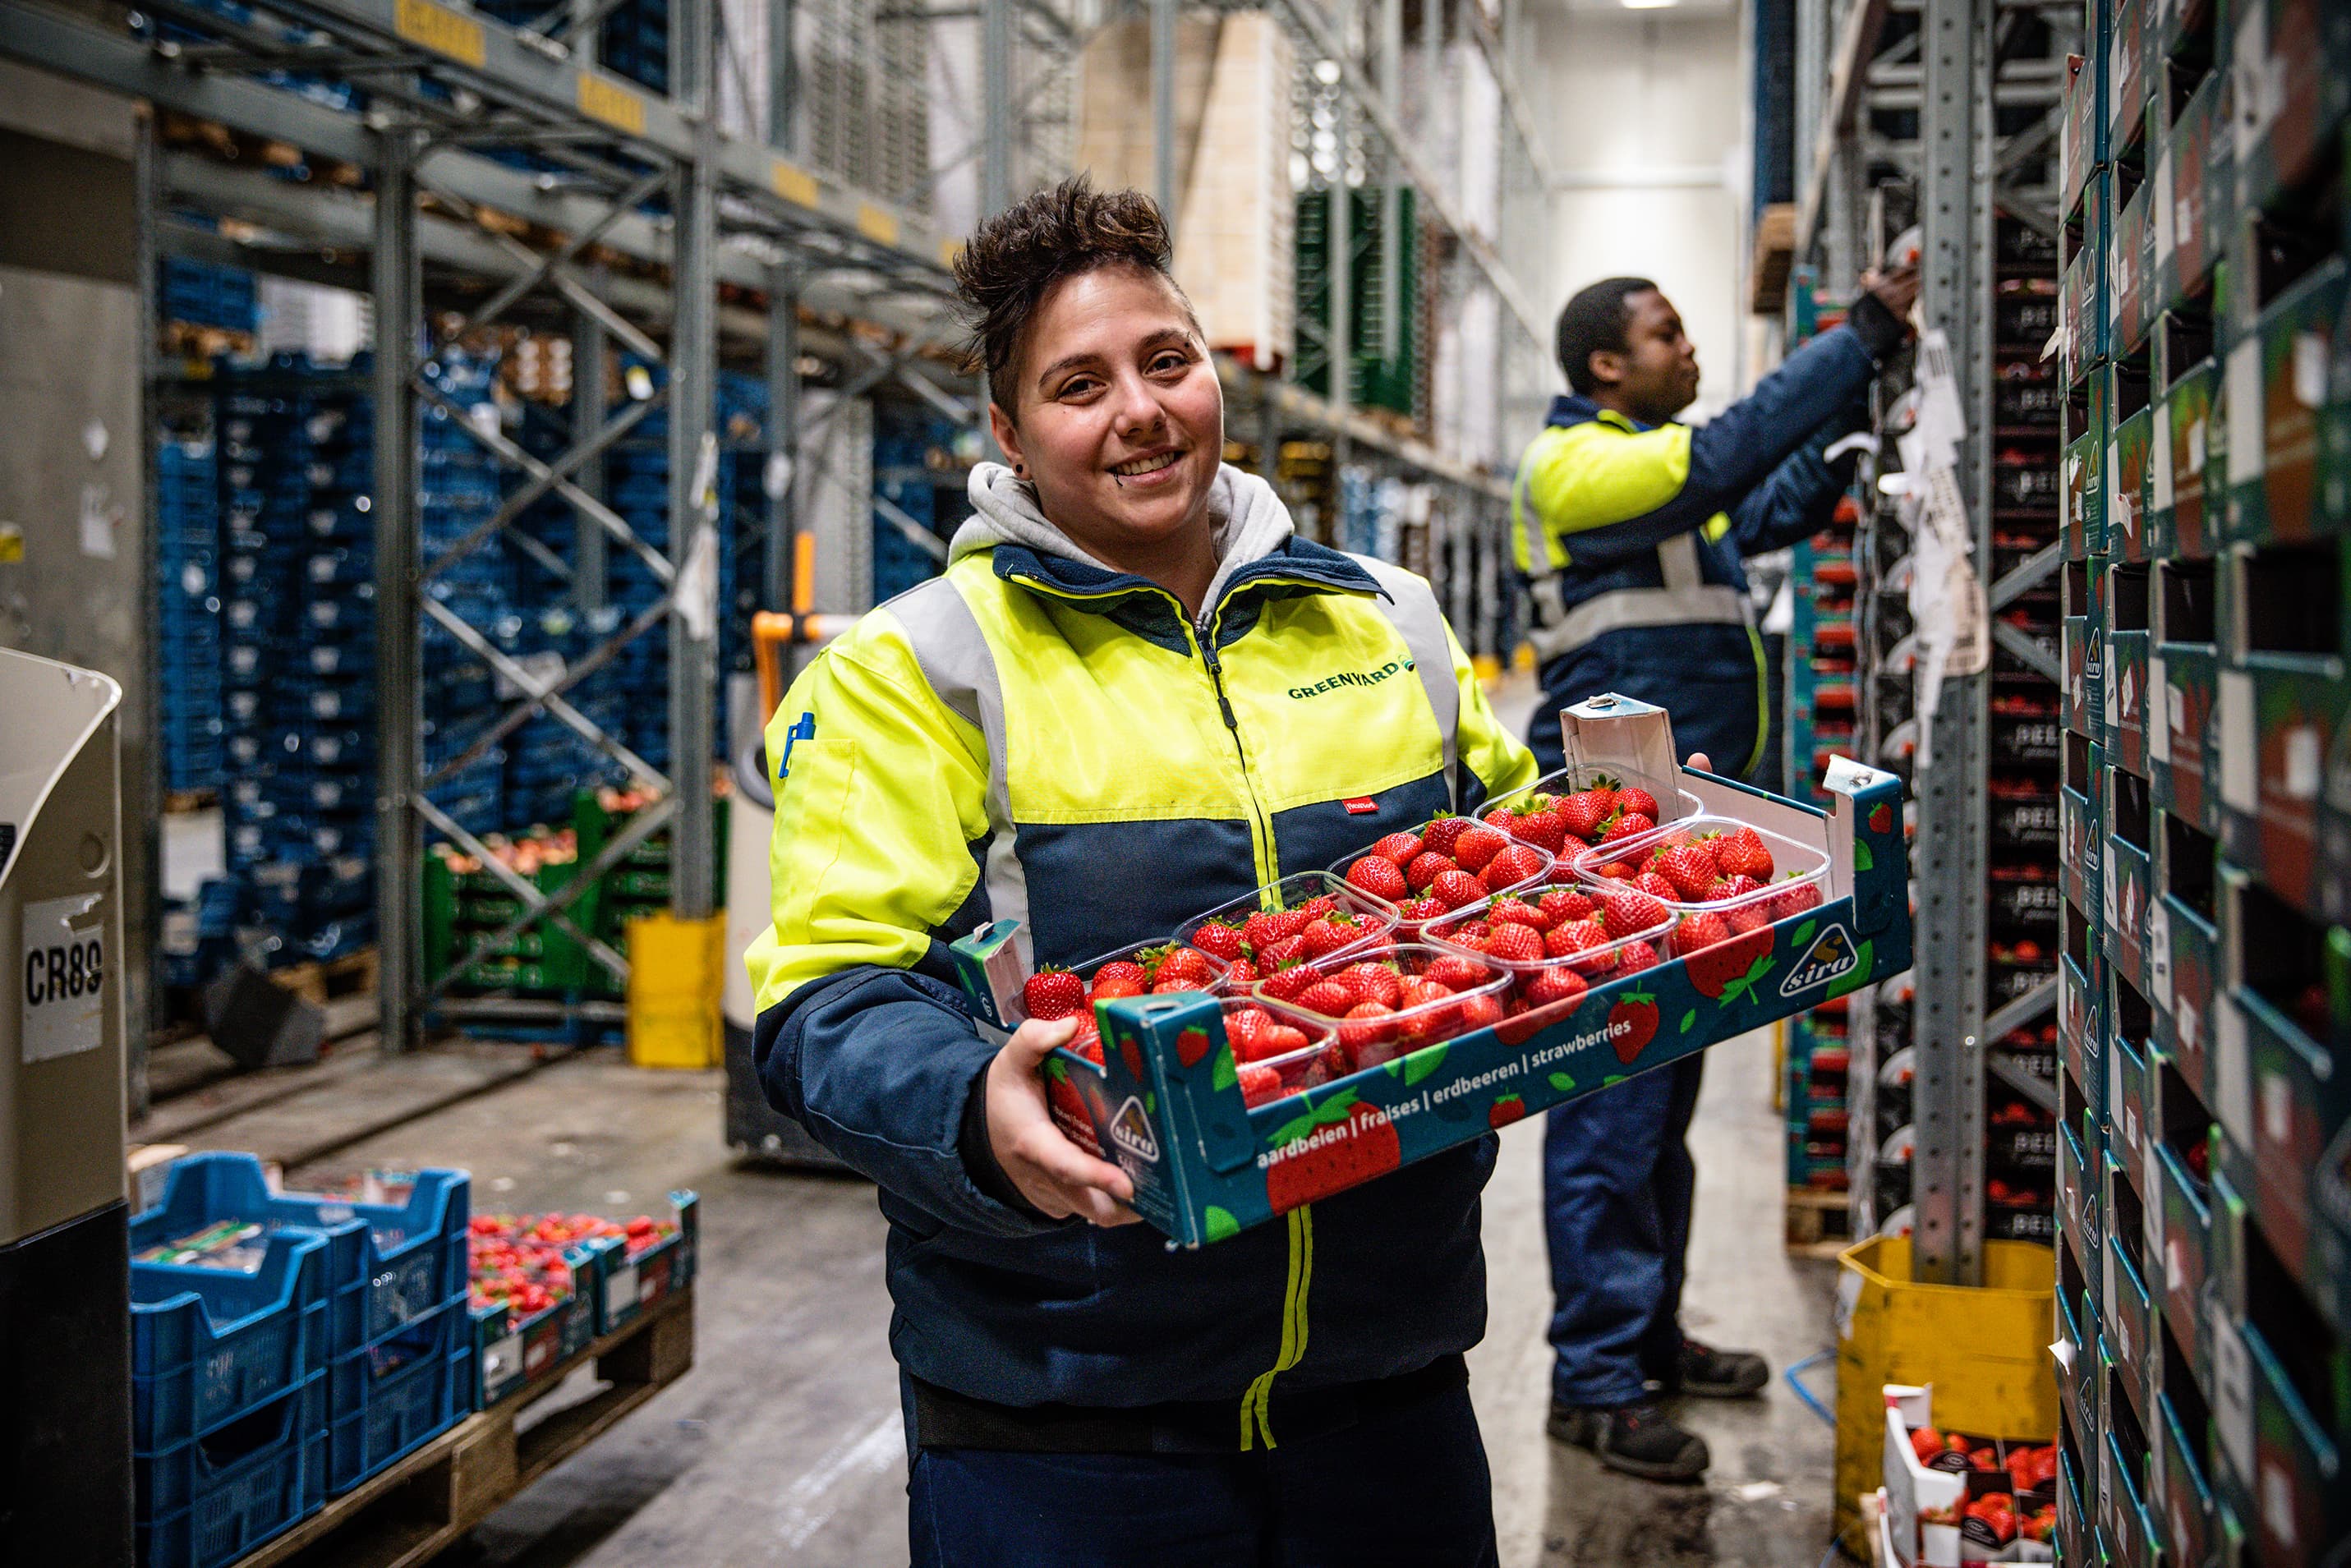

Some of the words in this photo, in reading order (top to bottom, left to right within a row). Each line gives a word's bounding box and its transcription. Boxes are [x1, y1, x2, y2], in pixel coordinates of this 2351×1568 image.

[1288, 662, 1399, 699] GREENYARD
[1787, 956, 1850, 990] sira
[1257, 1124, 1348, 1170] aardbeien
[1360, 1097, 1420, 1131] fraises
[1433, 1061, 1520, 1105] erdbeeren
[1531, 1019, 1631, 1069] strawberries
